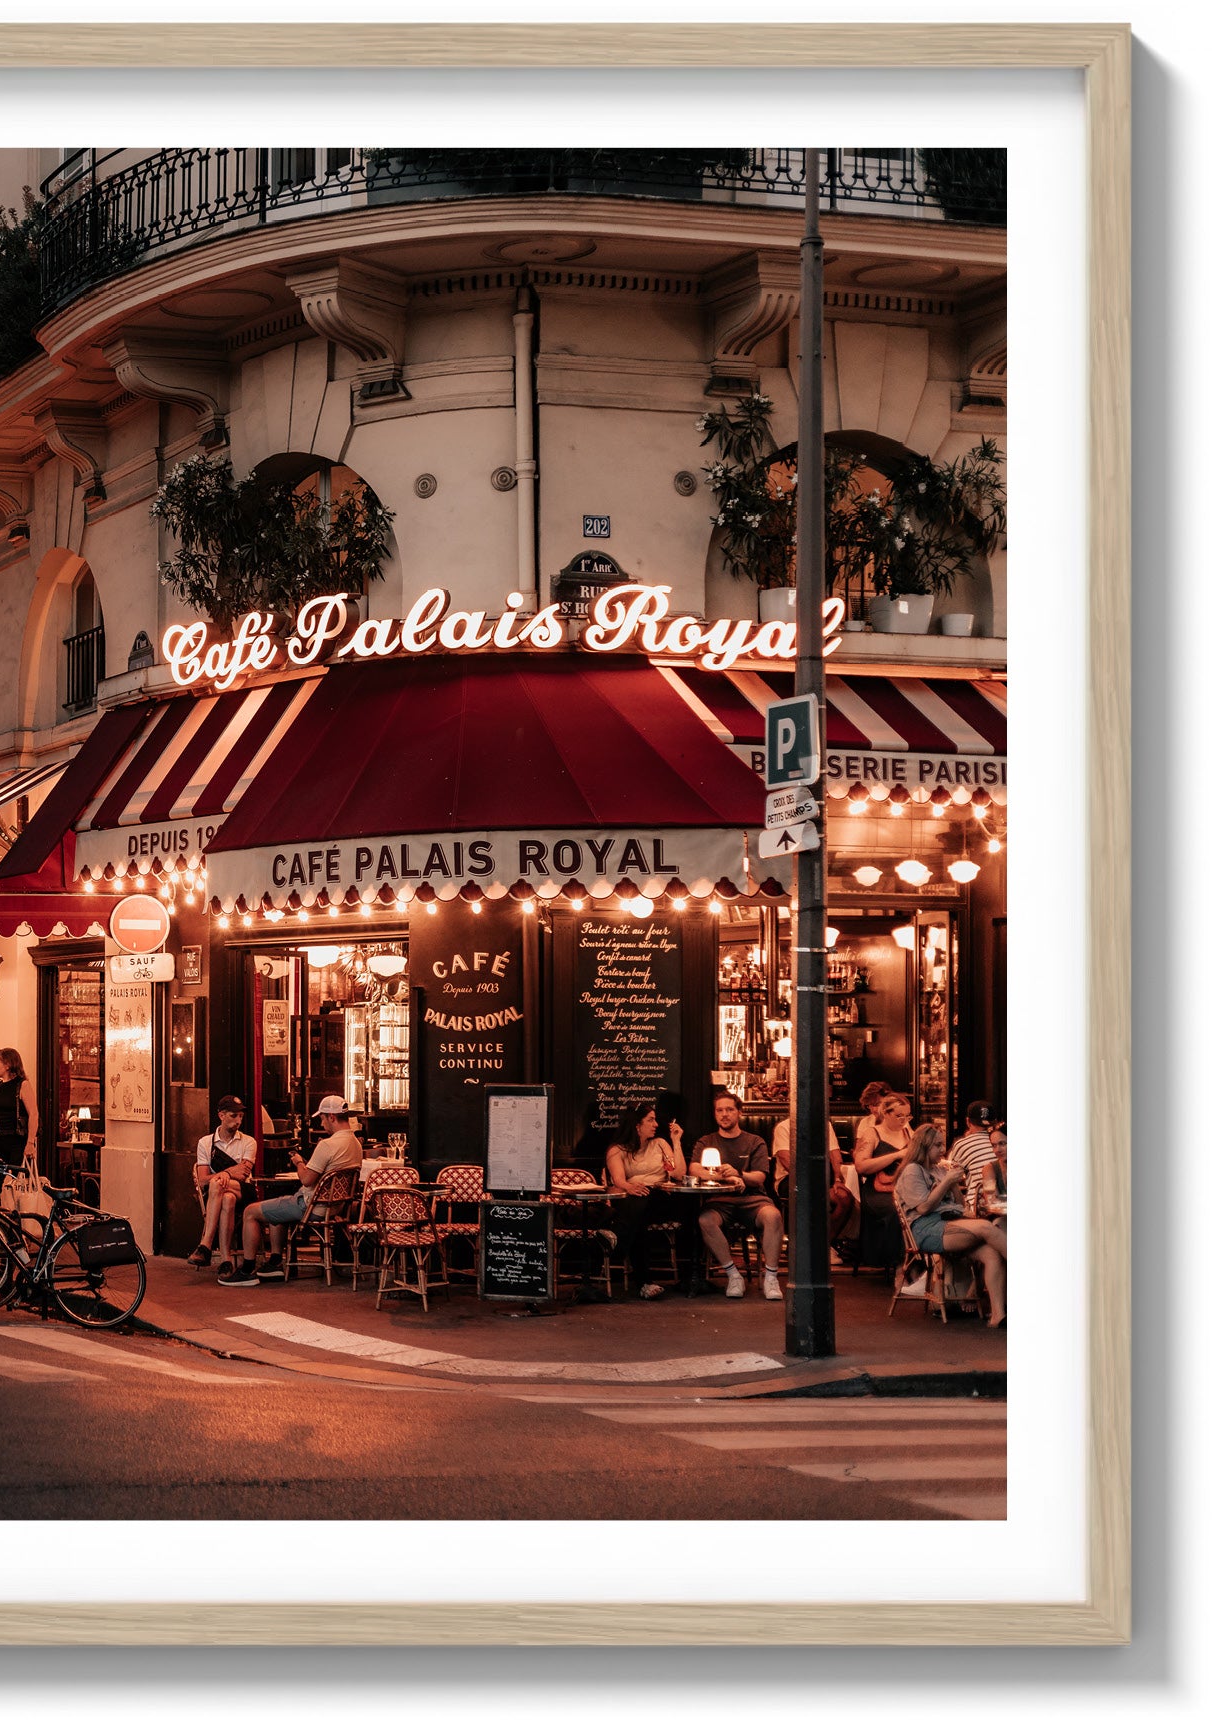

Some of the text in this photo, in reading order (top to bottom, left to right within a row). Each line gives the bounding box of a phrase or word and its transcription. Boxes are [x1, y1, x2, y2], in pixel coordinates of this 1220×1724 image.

[586, 518, 608, 535] 202
[163, 585, 845, 690] Café Palais Royal
[777, 717, 797, 770] P
[751, 751, 1007, 786] BSERIE PARISI
[786, 794, 795, 805] DES
[767, 802, 813, 824] PETITS CHAMPS
[128, 824, 223, 856] DEPUIS 19
[272, 838, 681, 887] CAFÉ PALAIS ROYAL
[581, 921, 610, 934] Poulet
[645, 923, 671, 940] four
[579, 937, 605, 948] Souris
[130, 957, 156, 966] SAUF
[186, 952, 196, 962] RUE
[597, 951, 621, 966] Confit
[432, 951, 511, 979] CAFÉ
[597, 965, 625, 977] Tartare
[443, 982, 500, 998] Depuis 1903
[626, 979, 656, 989] boucher
[110, 987, 148, 998] PALAIS ROYAL
[579, 992, 606, 1007] Royal
[656, 994, 680, 1007] burger
[271, 1005, 281, 1013] VIN
[424, 1006, 524, 1032] PALAIS ROYAL
[629, 1023, 656, 1031] saumon
[440, 1043, 504, 1053] SERVICE
[440, 1059, 504, 1069] CONTINU
